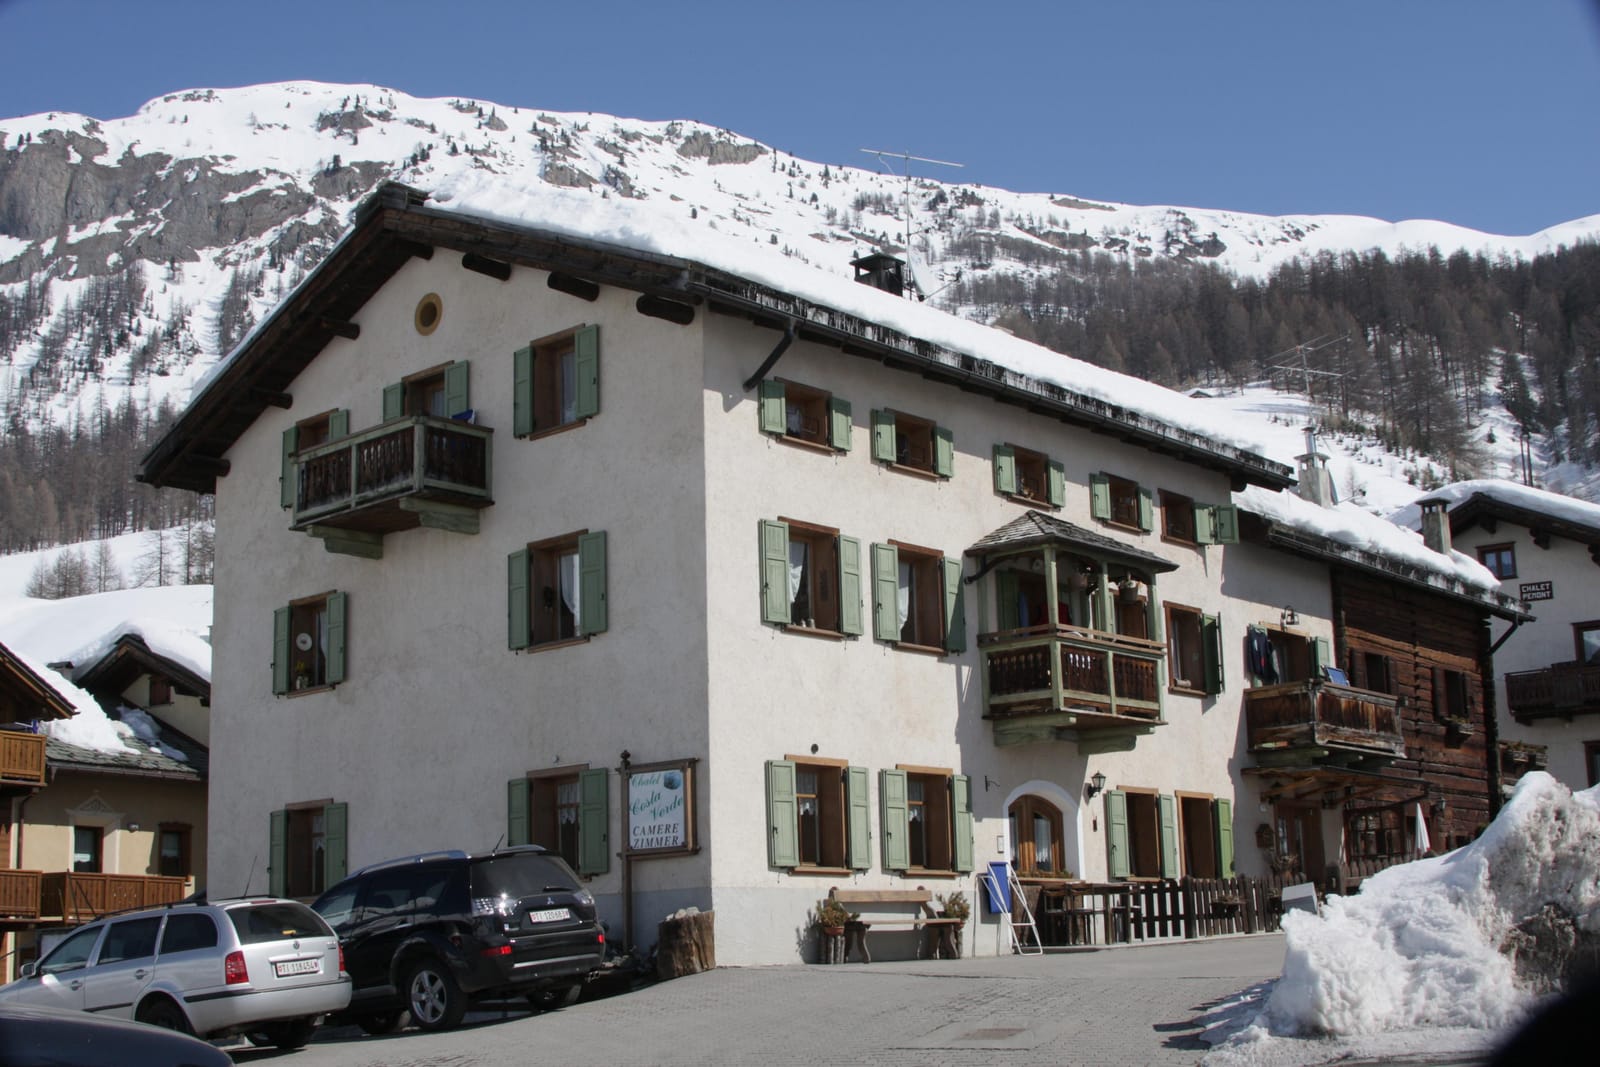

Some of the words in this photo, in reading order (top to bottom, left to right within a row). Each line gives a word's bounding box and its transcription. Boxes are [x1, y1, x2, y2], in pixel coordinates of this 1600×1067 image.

[1521, 583, 1550, 592] CHALET
[630, 790, 661, 816] Costa
[650, 795, 683, 821] Verde
[632, 823, 680, 837] CAMERE
[633, 836, 679, 849] ZIMMER
